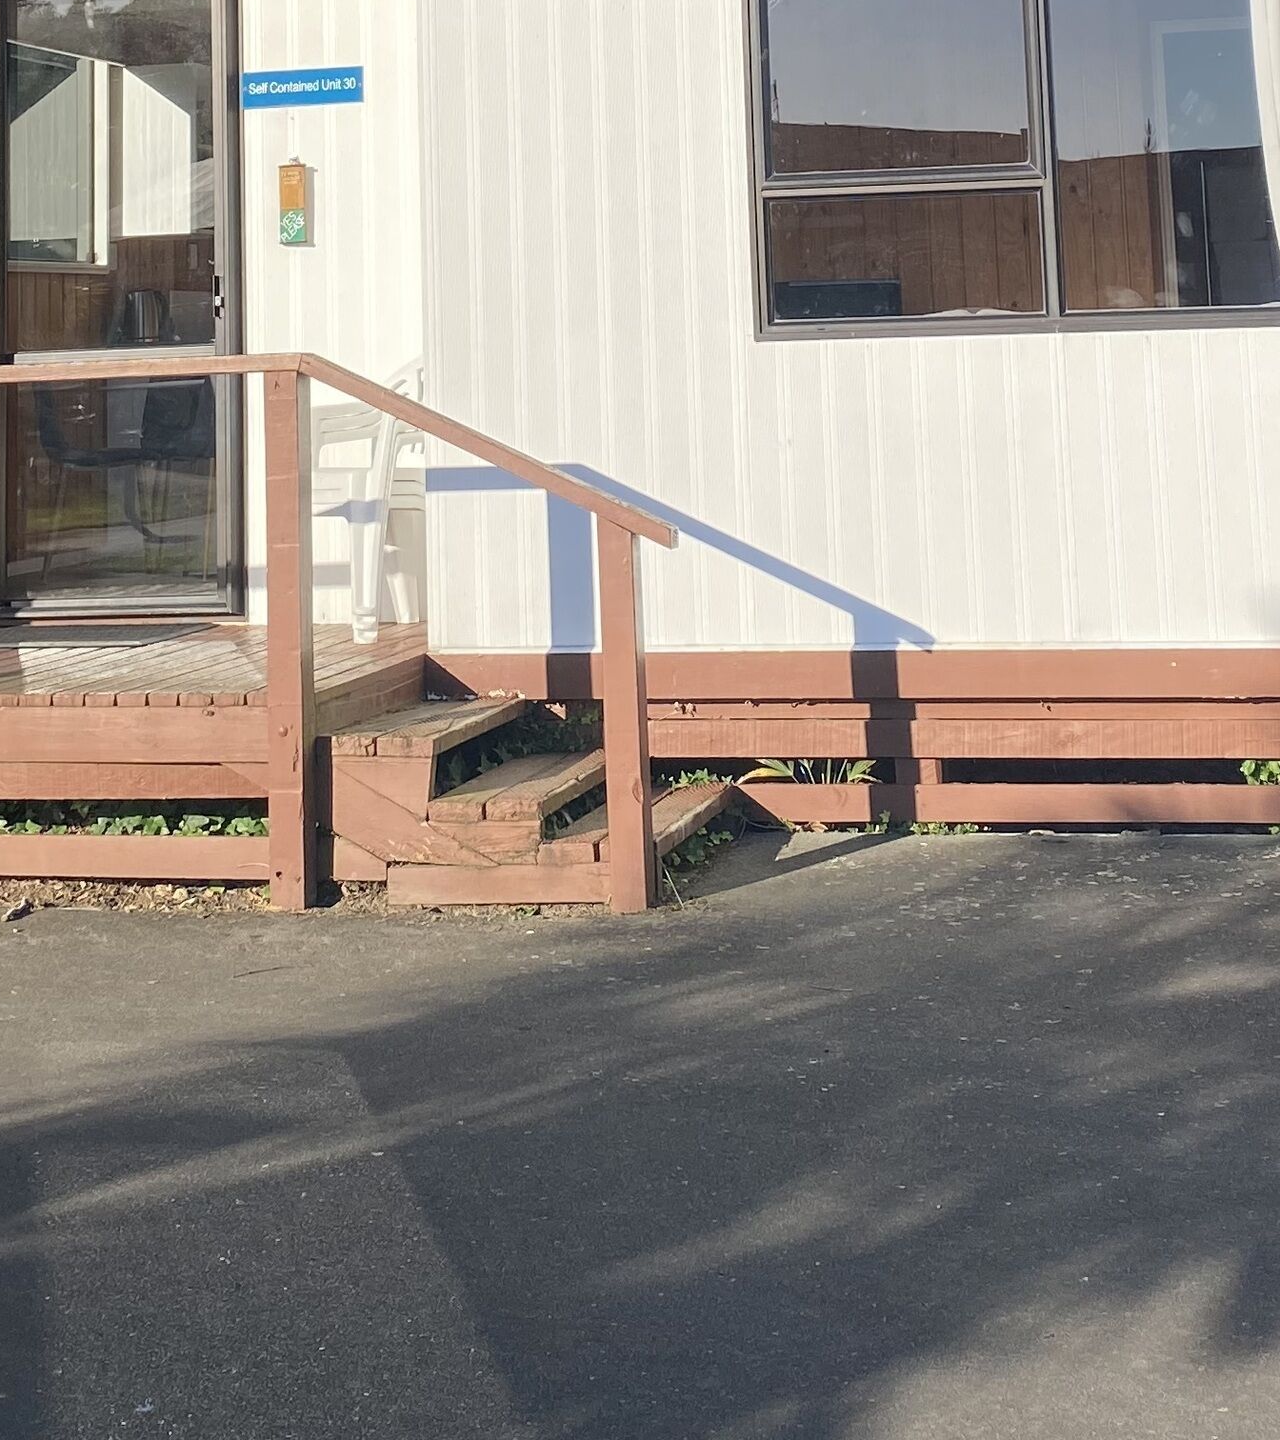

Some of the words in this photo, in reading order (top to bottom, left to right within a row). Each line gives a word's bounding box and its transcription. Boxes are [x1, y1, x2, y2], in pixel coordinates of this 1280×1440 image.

[248, 81, 268, 95] Self
[269, 79, 320, 94] Contained
[321, 77, 342, 91] Unit
[343, 76, 357, 90] 30
[280, 211, 297, 229] YES
[280, 212, 305, 244] PLEASE
